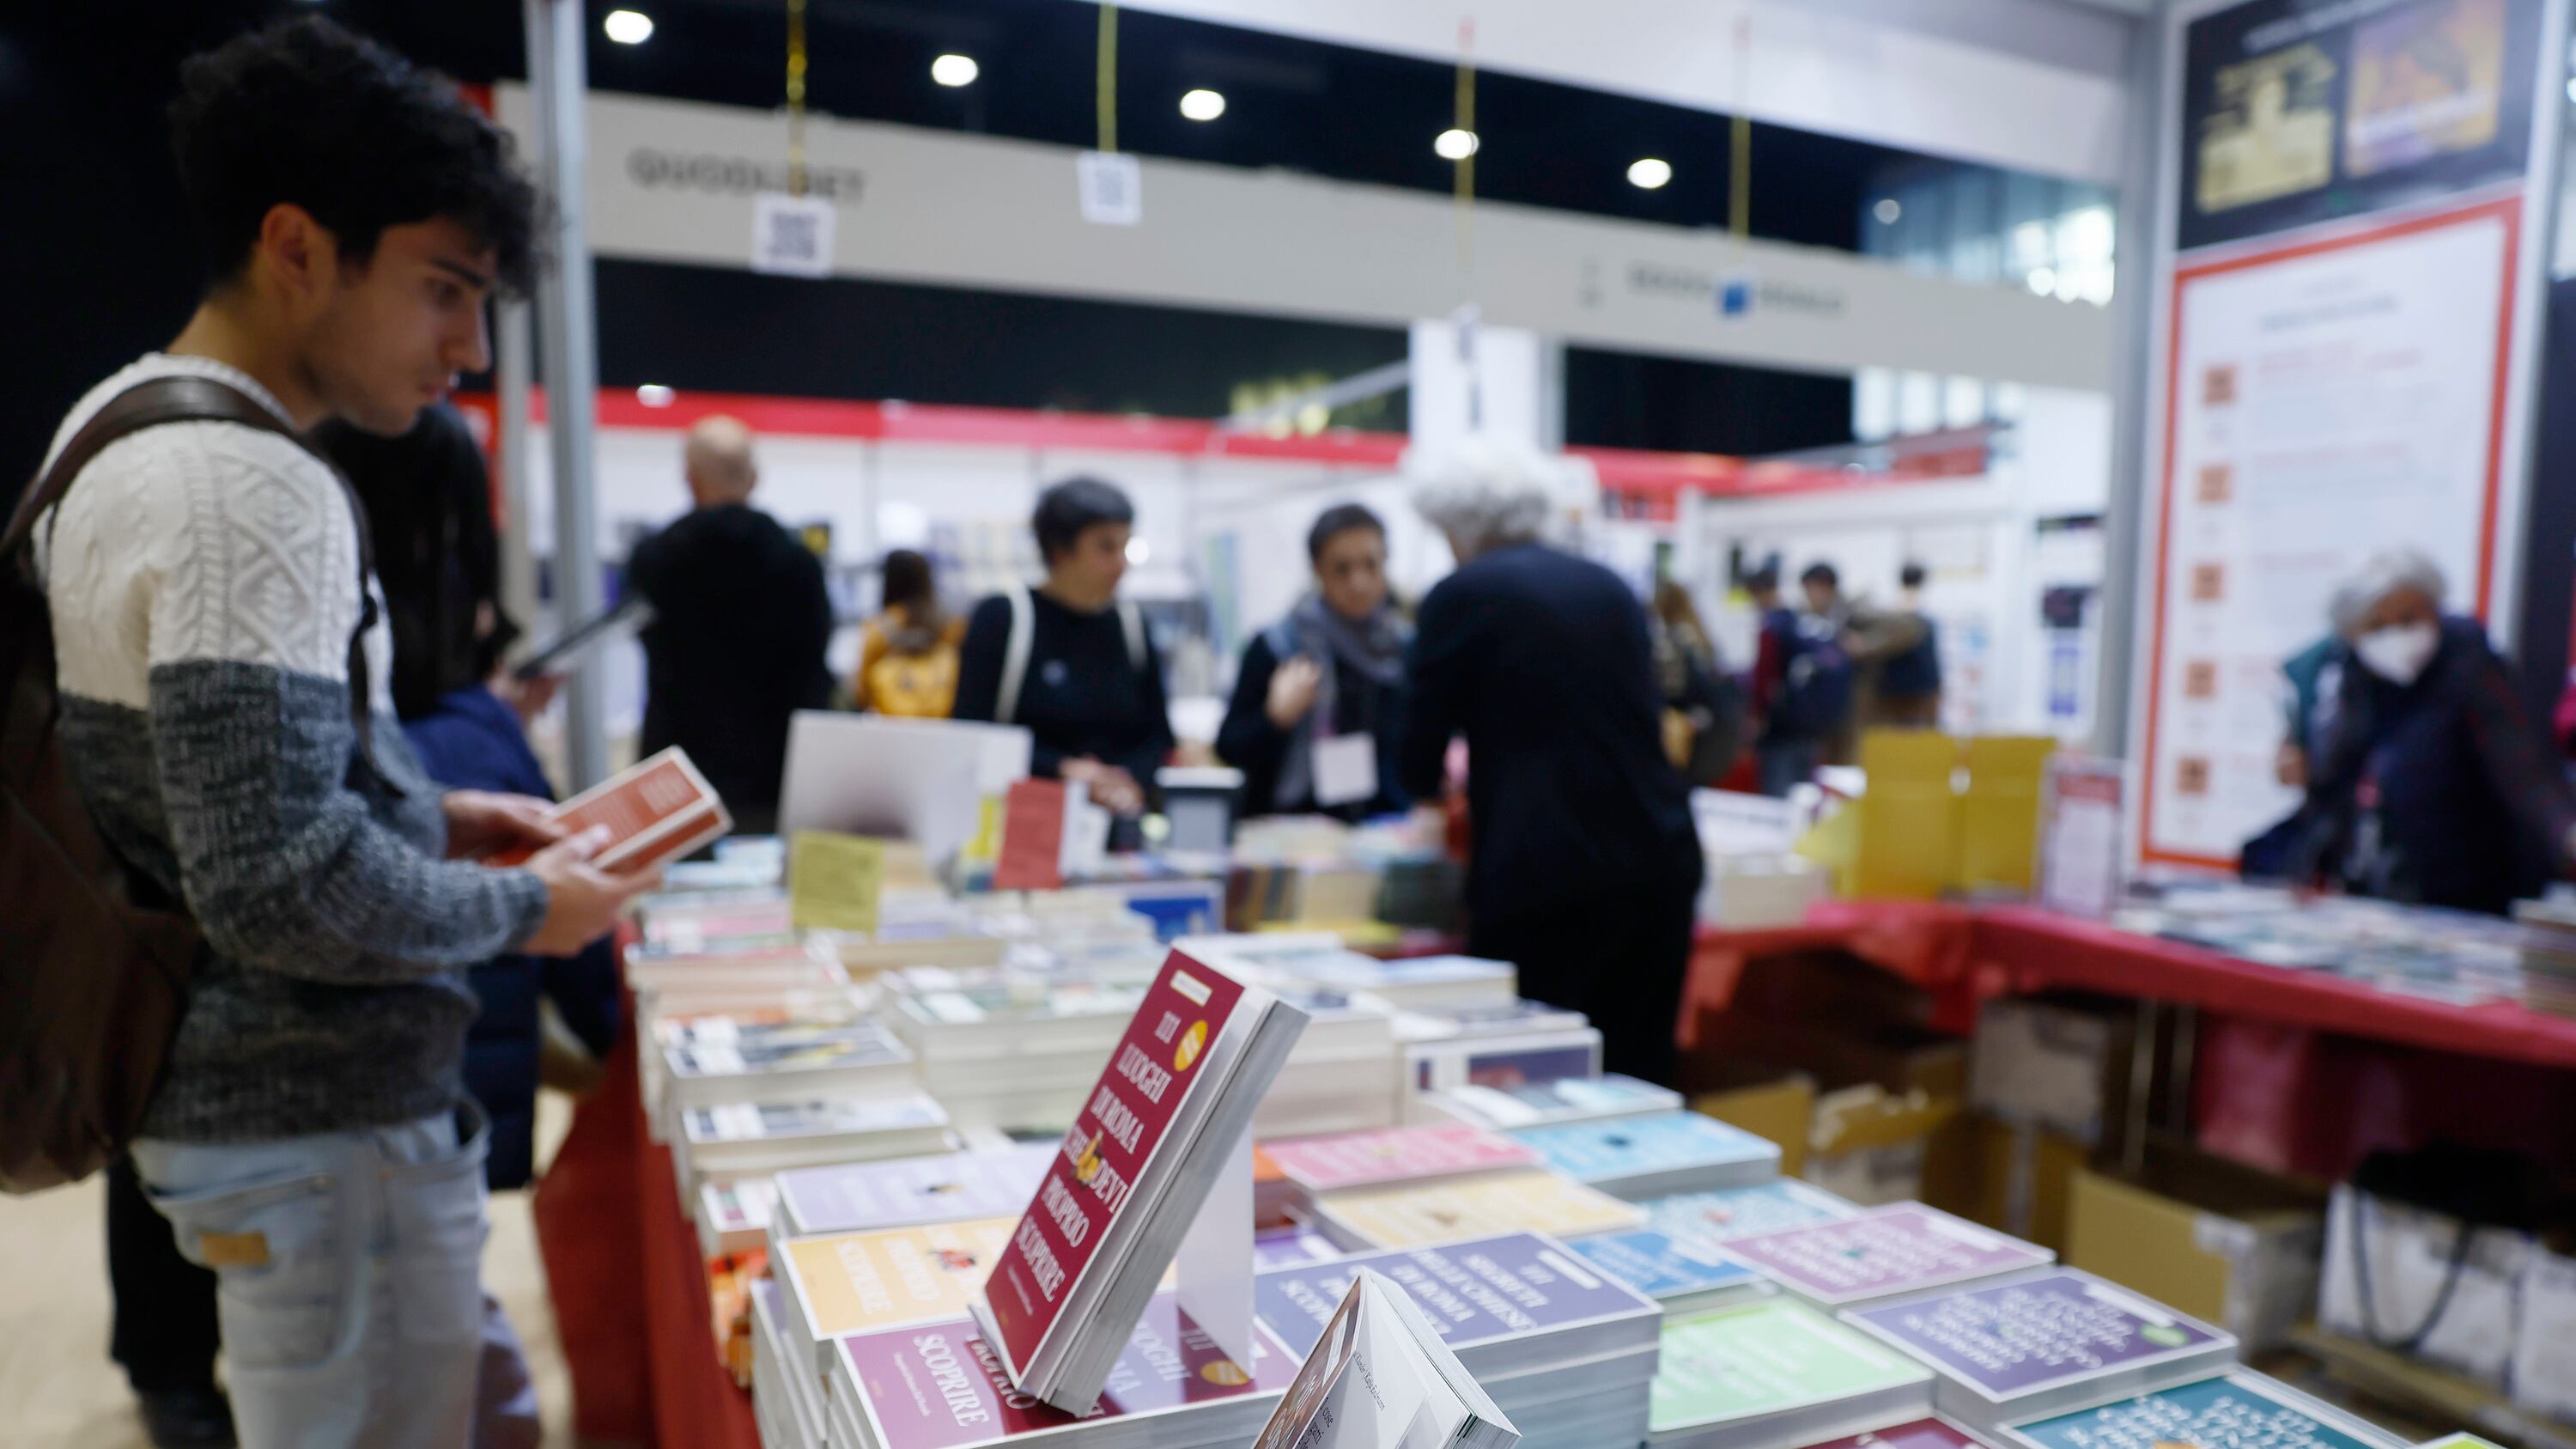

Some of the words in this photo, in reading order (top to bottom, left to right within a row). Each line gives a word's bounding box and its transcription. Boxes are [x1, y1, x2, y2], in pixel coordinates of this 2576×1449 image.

[1116, 1042, 1173, 1105] LUOGHI
[1101, 1096, 1145, 1154] ROMA
[913, 1333, 990, 1428] SCOPRIRE
[1322, 1407, 1334, 1428] cose
